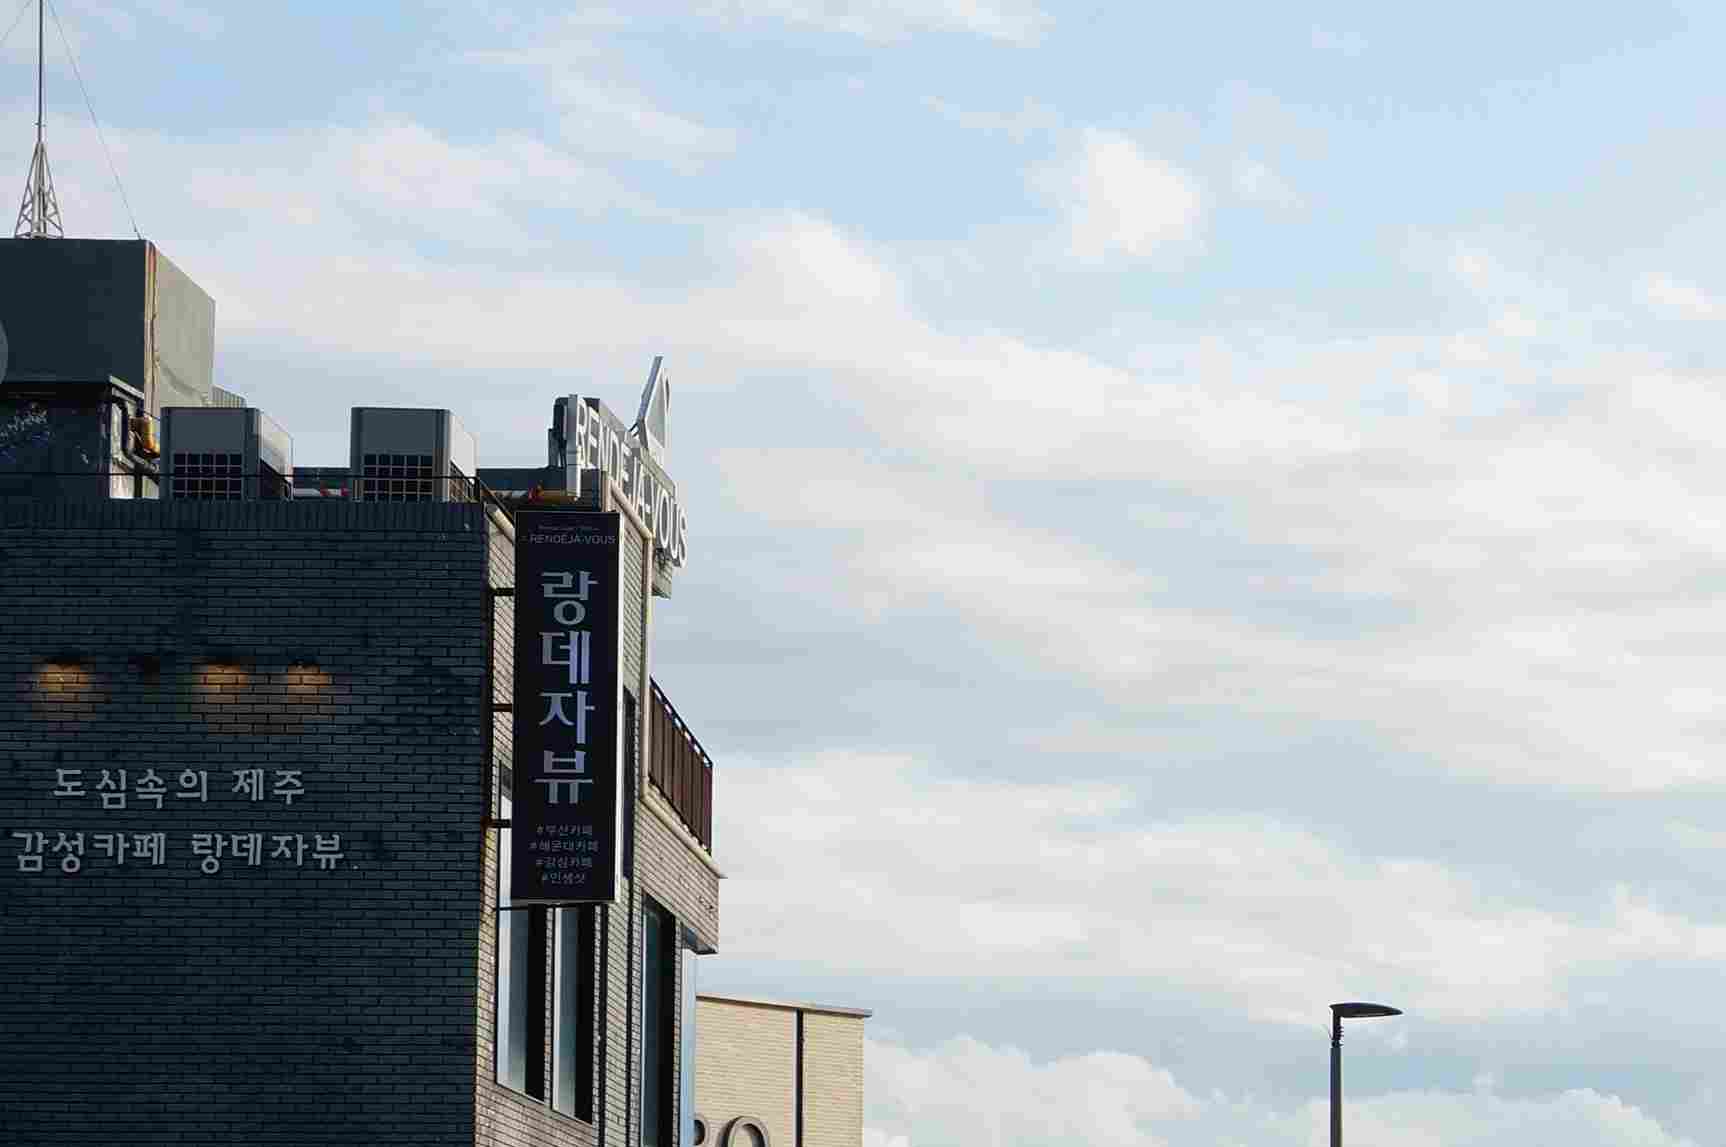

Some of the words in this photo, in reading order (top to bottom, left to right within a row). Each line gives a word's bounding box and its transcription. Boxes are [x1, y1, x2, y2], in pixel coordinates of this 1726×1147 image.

[535, 570, 598, 806] 랑데자뷰
[53, 767, 209, 809] 도심속의
[232, 767, 305, 806] 제주
[13, 831, 168, 874] 감성카페
